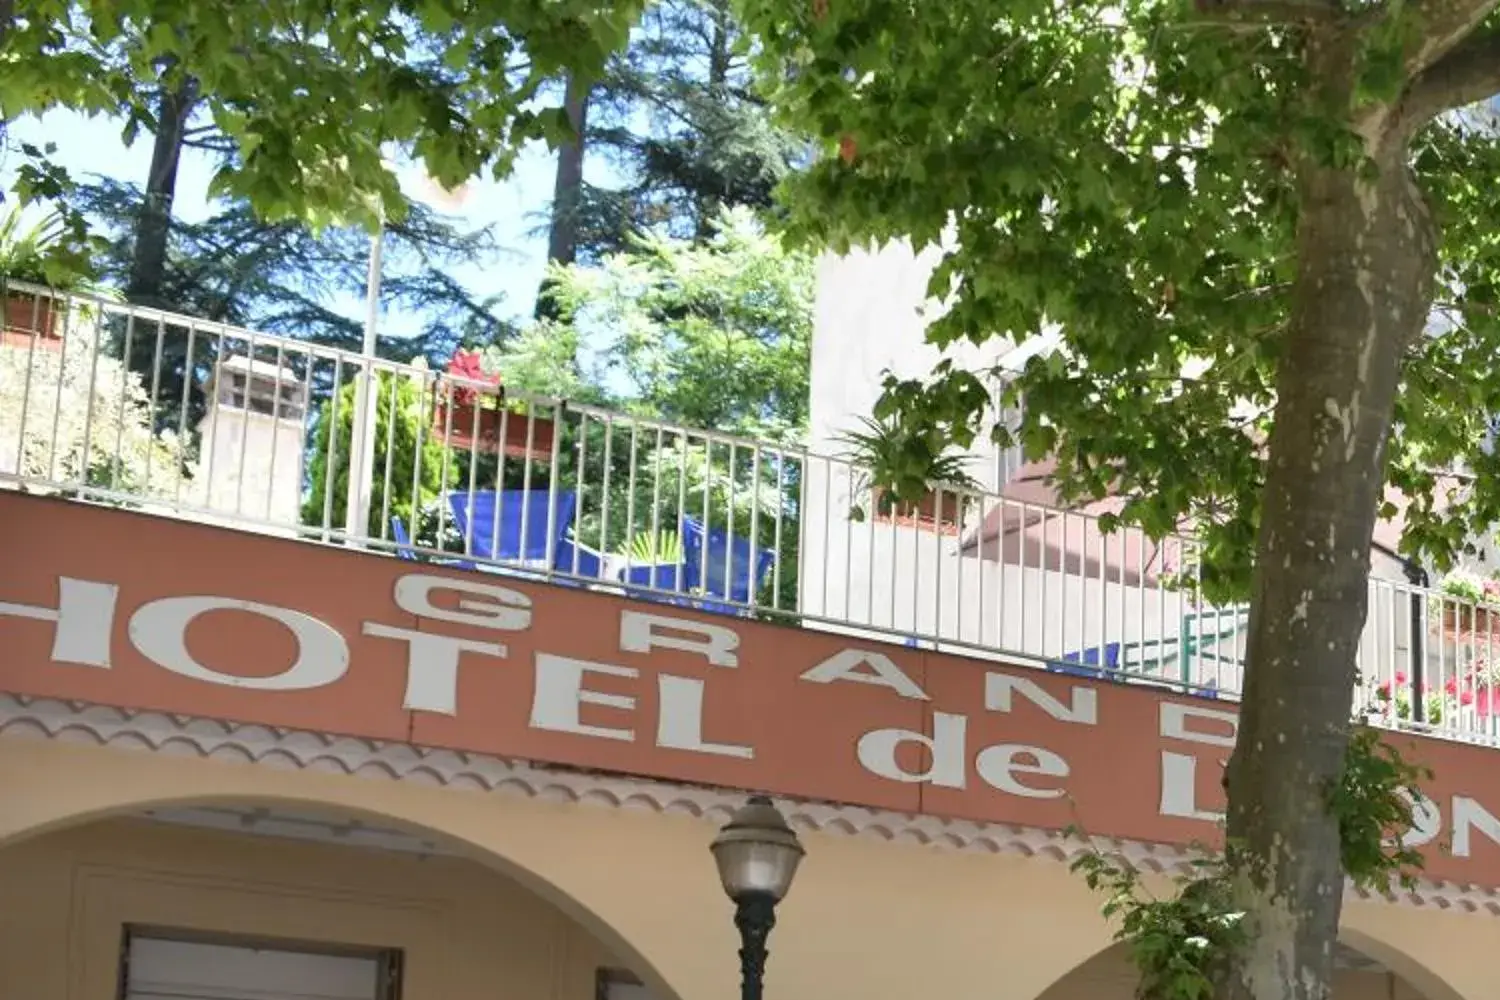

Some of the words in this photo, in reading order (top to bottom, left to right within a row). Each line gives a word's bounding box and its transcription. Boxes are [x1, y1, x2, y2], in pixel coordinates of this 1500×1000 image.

[0, 575, 758, 760] HOTEL
[856, 711, 1071, 799] de
[393, 572, 1240, 748] GRAND
